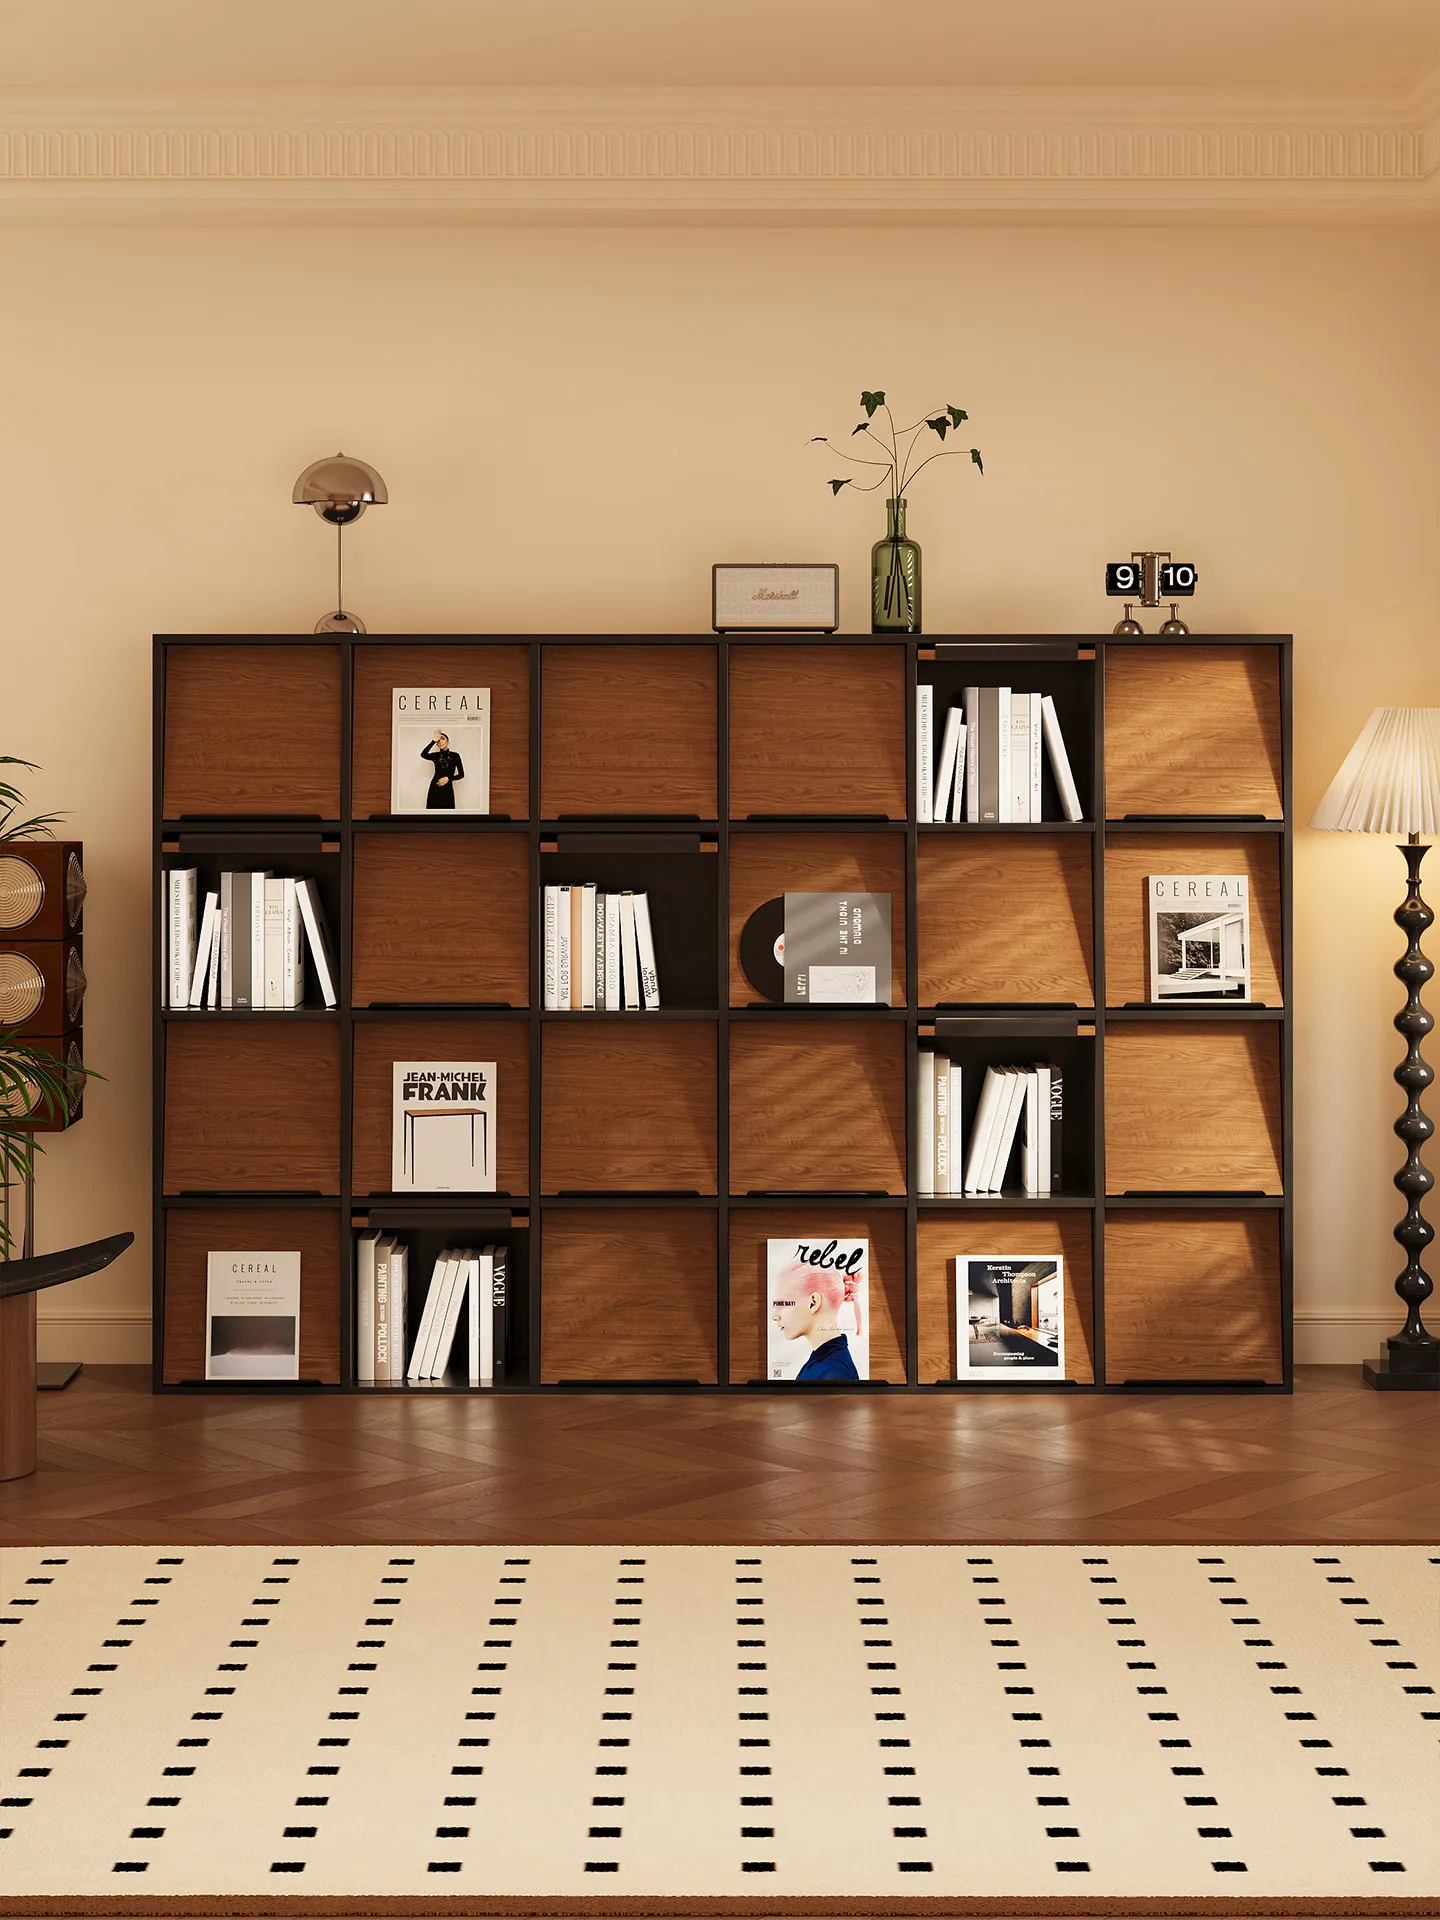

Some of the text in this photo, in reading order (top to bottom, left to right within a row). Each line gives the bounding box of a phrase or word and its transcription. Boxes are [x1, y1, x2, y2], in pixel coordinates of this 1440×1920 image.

[1116, 566, 1194, 589] 9 10
[752, 588, 800, 600] Marshall
[398, 695, 484, 710] CEREAL
[1156, 881, 1243, 897] CEREAL
[403, 1072, 487, 1082] JEAN-MICHEL
[403, 1083, 487, 1101] FRANK
[937, 1076, 947, 1116] PAINTING
[1050, 1078, 1063, 1121] VOGUE
[937, 1136, 947, 1176] POLLOCK
[232, 1264, 276, 1273] CEREAL
[794, 1240, 864, 1276] rebel
[377, 1263, 387, 1303] PAINTING
[493, 1265, 506, 1307] VOGUE
[377, 1323, 387, 1363] POLLOCK
